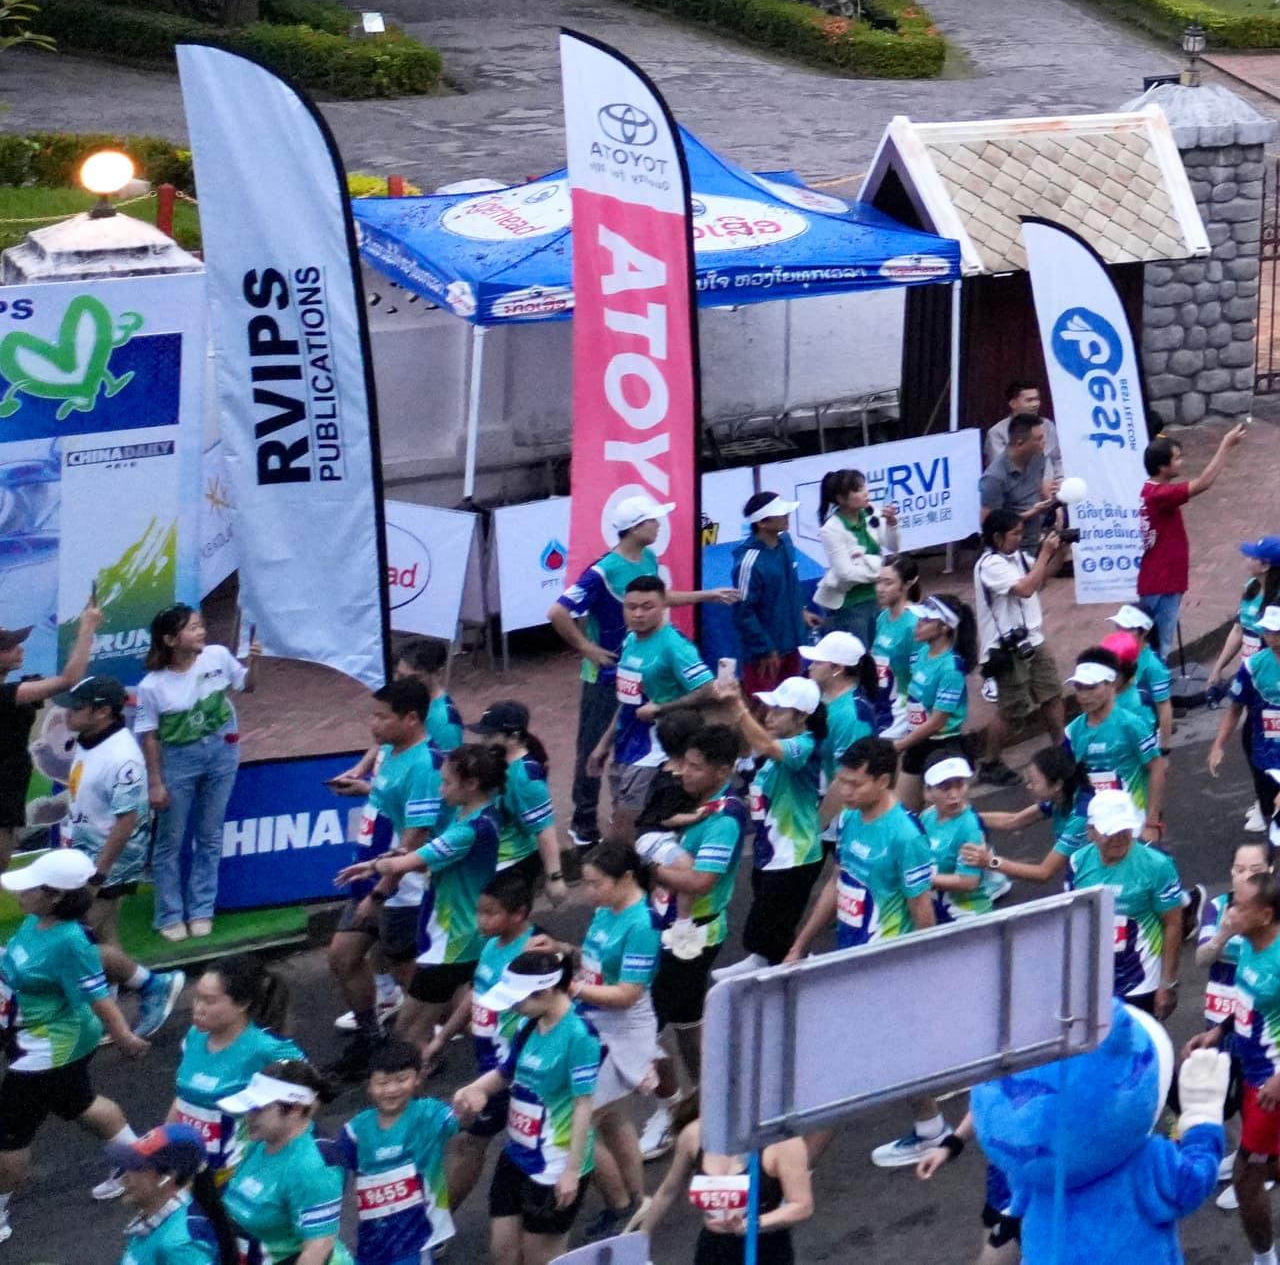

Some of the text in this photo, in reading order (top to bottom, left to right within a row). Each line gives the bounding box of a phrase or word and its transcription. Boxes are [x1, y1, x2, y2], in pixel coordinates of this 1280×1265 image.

[243, 267, 312, 485] RVIPS
[301, 265, 343, 482] PUBLICATIONS
[888, 457, 950, 498] RVI
[222, 809, 344, 858] HINA
